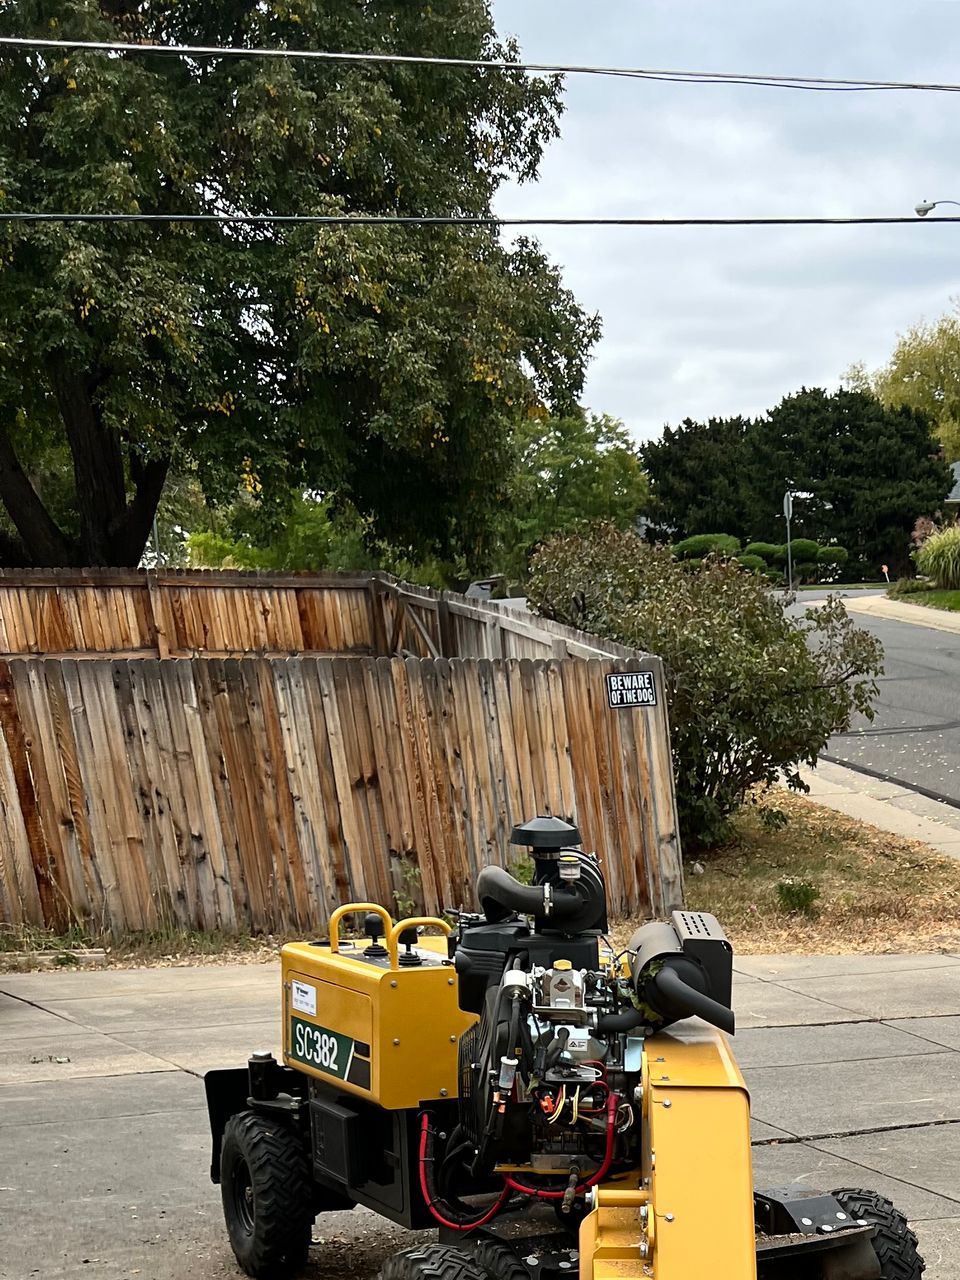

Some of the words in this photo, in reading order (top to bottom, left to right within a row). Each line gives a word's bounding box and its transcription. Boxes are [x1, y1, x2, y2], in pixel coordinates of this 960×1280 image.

[610, 675, 650, 690] BEWARE
[612, 691, 621, 704] OF
[622, 690, 637, 703] THE
[637, 689, 653, 701] DOG
[296, 1023, 338, 1071] SC382
